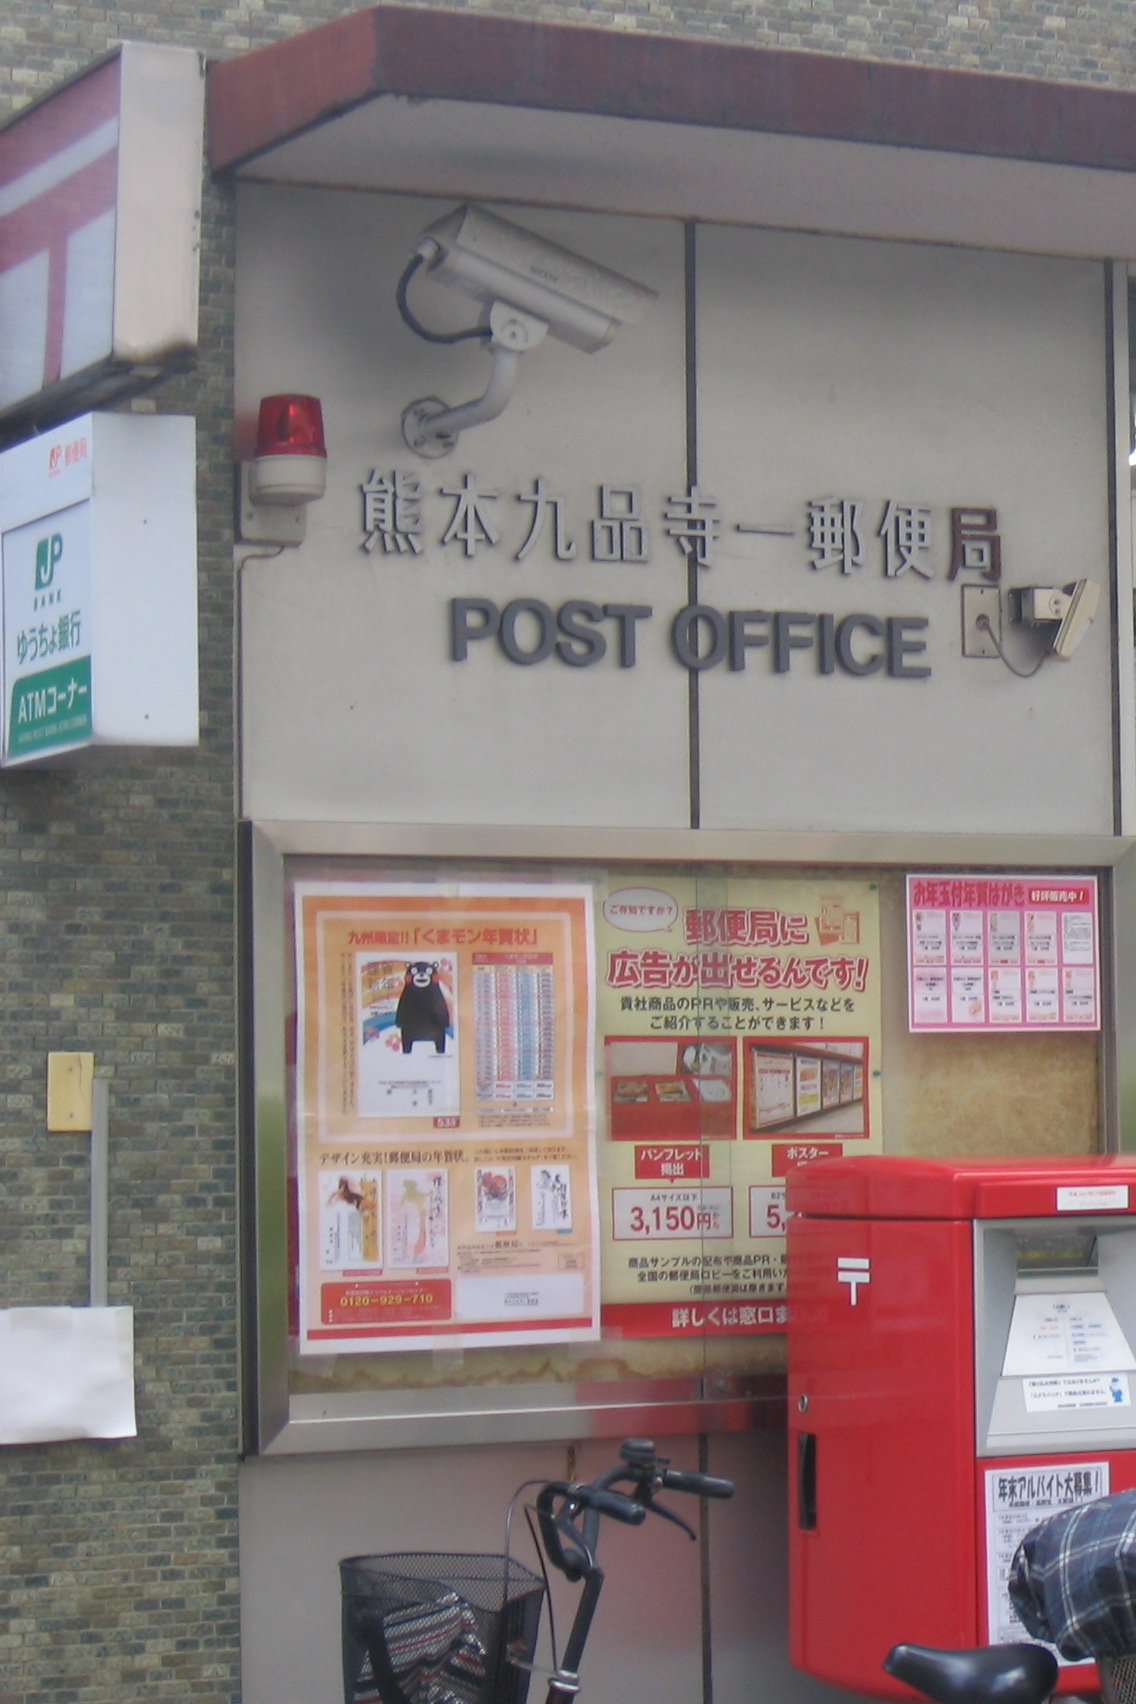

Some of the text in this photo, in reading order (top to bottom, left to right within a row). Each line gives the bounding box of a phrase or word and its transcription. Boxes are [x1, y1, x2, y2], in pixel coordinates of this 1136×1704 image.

[360, 469, 1001, 581] 熊本九品寺一郵便局
[17, 610, 81, 664] ゆうちょ銀行
[450, 598, 931, 678] POST OFFICE
[18, 679, 88, 723] ATMコーナー
[913, 882, 1025, 907] お年玉付年賀はがき
[685, 908, 808, 944] 郵便局に
[608, 951, 869, 990] 広告が出せるんです!
[621, 996, 855, 1011] 貴社商品のPRや販売、サービスなどを
[650, 1015, 824, 1030] ご紹介することができます!
[641, 1148, 703, 1161] パンフレット
[786, 1147, 829, 1158] ポスター
[661, 1163, 684, 1176] 掲出
[650, 1194, 698, 1202] A4サイズ以下
[630, 1205, 711, 1233] 3,150円
[340, 1294, 433, 1306] 0120-929-710
[998, 1471, 1099, 1503] 年末アルバイト大募集!
